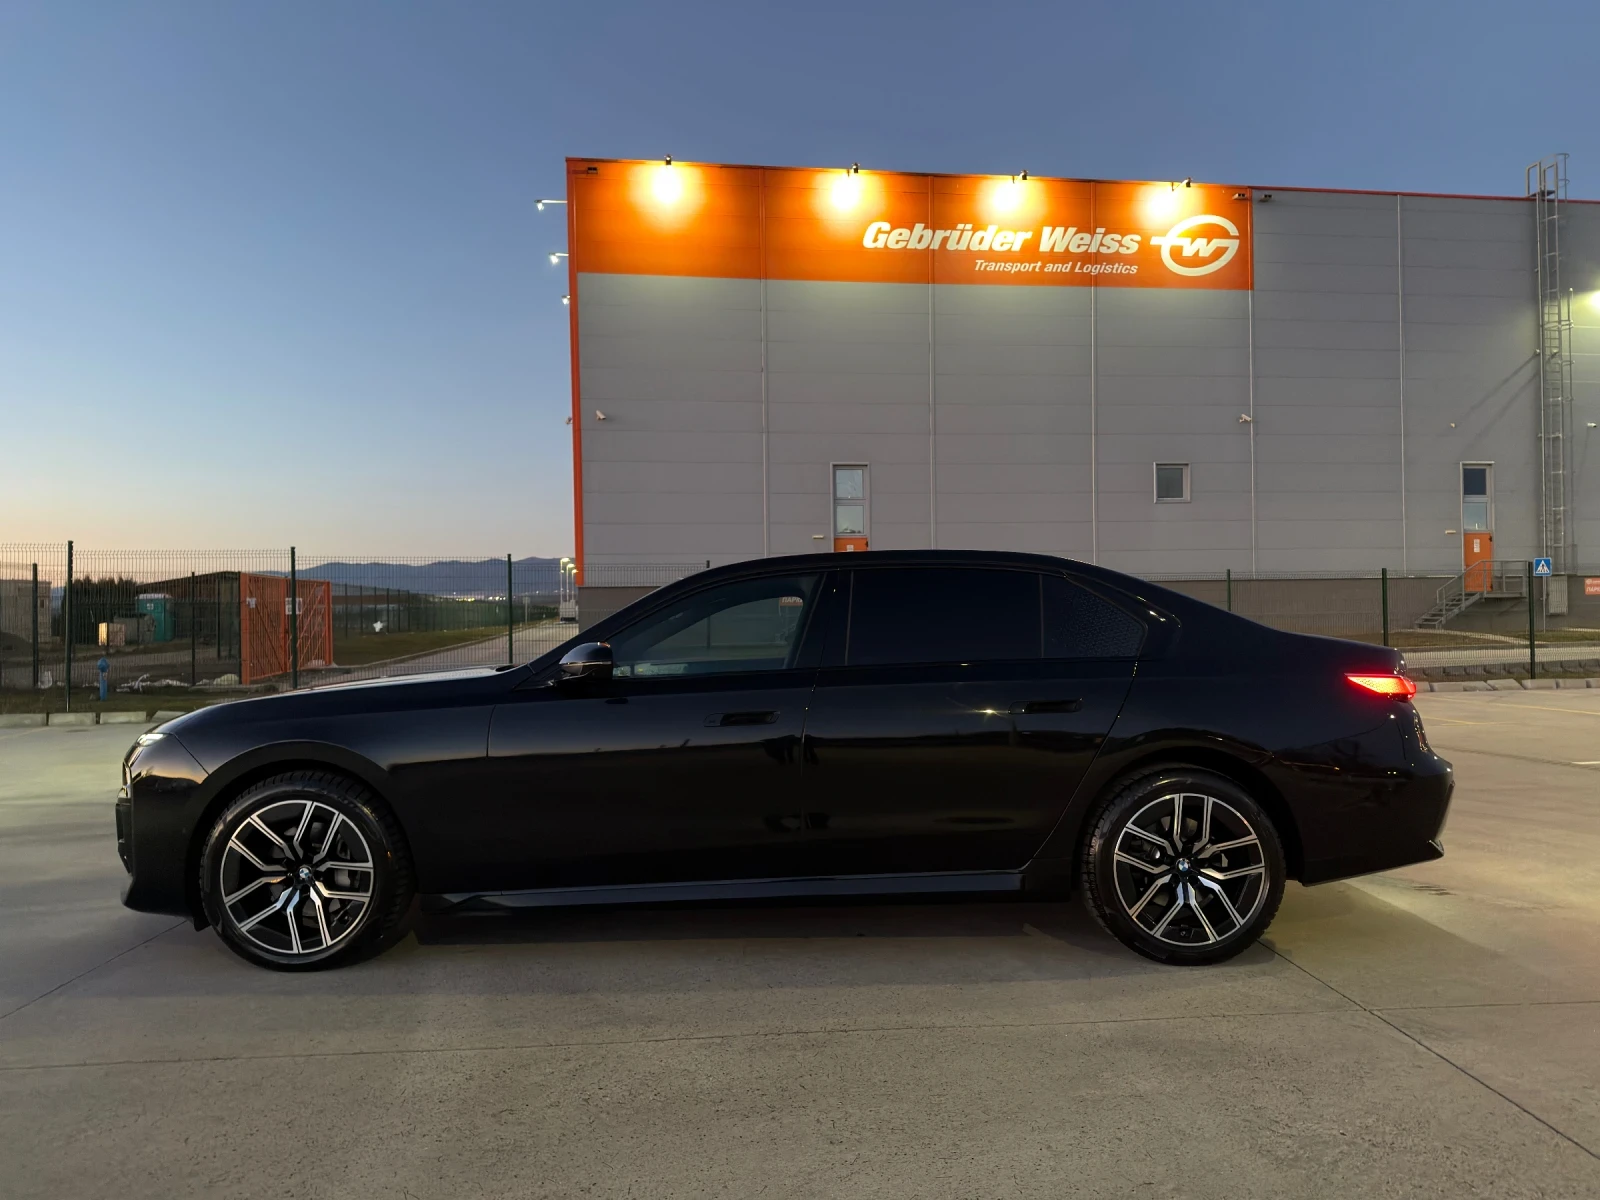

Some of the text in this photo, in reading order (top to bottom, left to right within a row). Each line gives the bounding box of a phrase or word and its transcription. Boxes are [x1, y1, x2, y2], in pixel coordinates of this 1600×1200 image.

[862, 221, 1142, 254] Gebrüder Weiss
[974, 259, 1139, 275] Transport and Logistics
